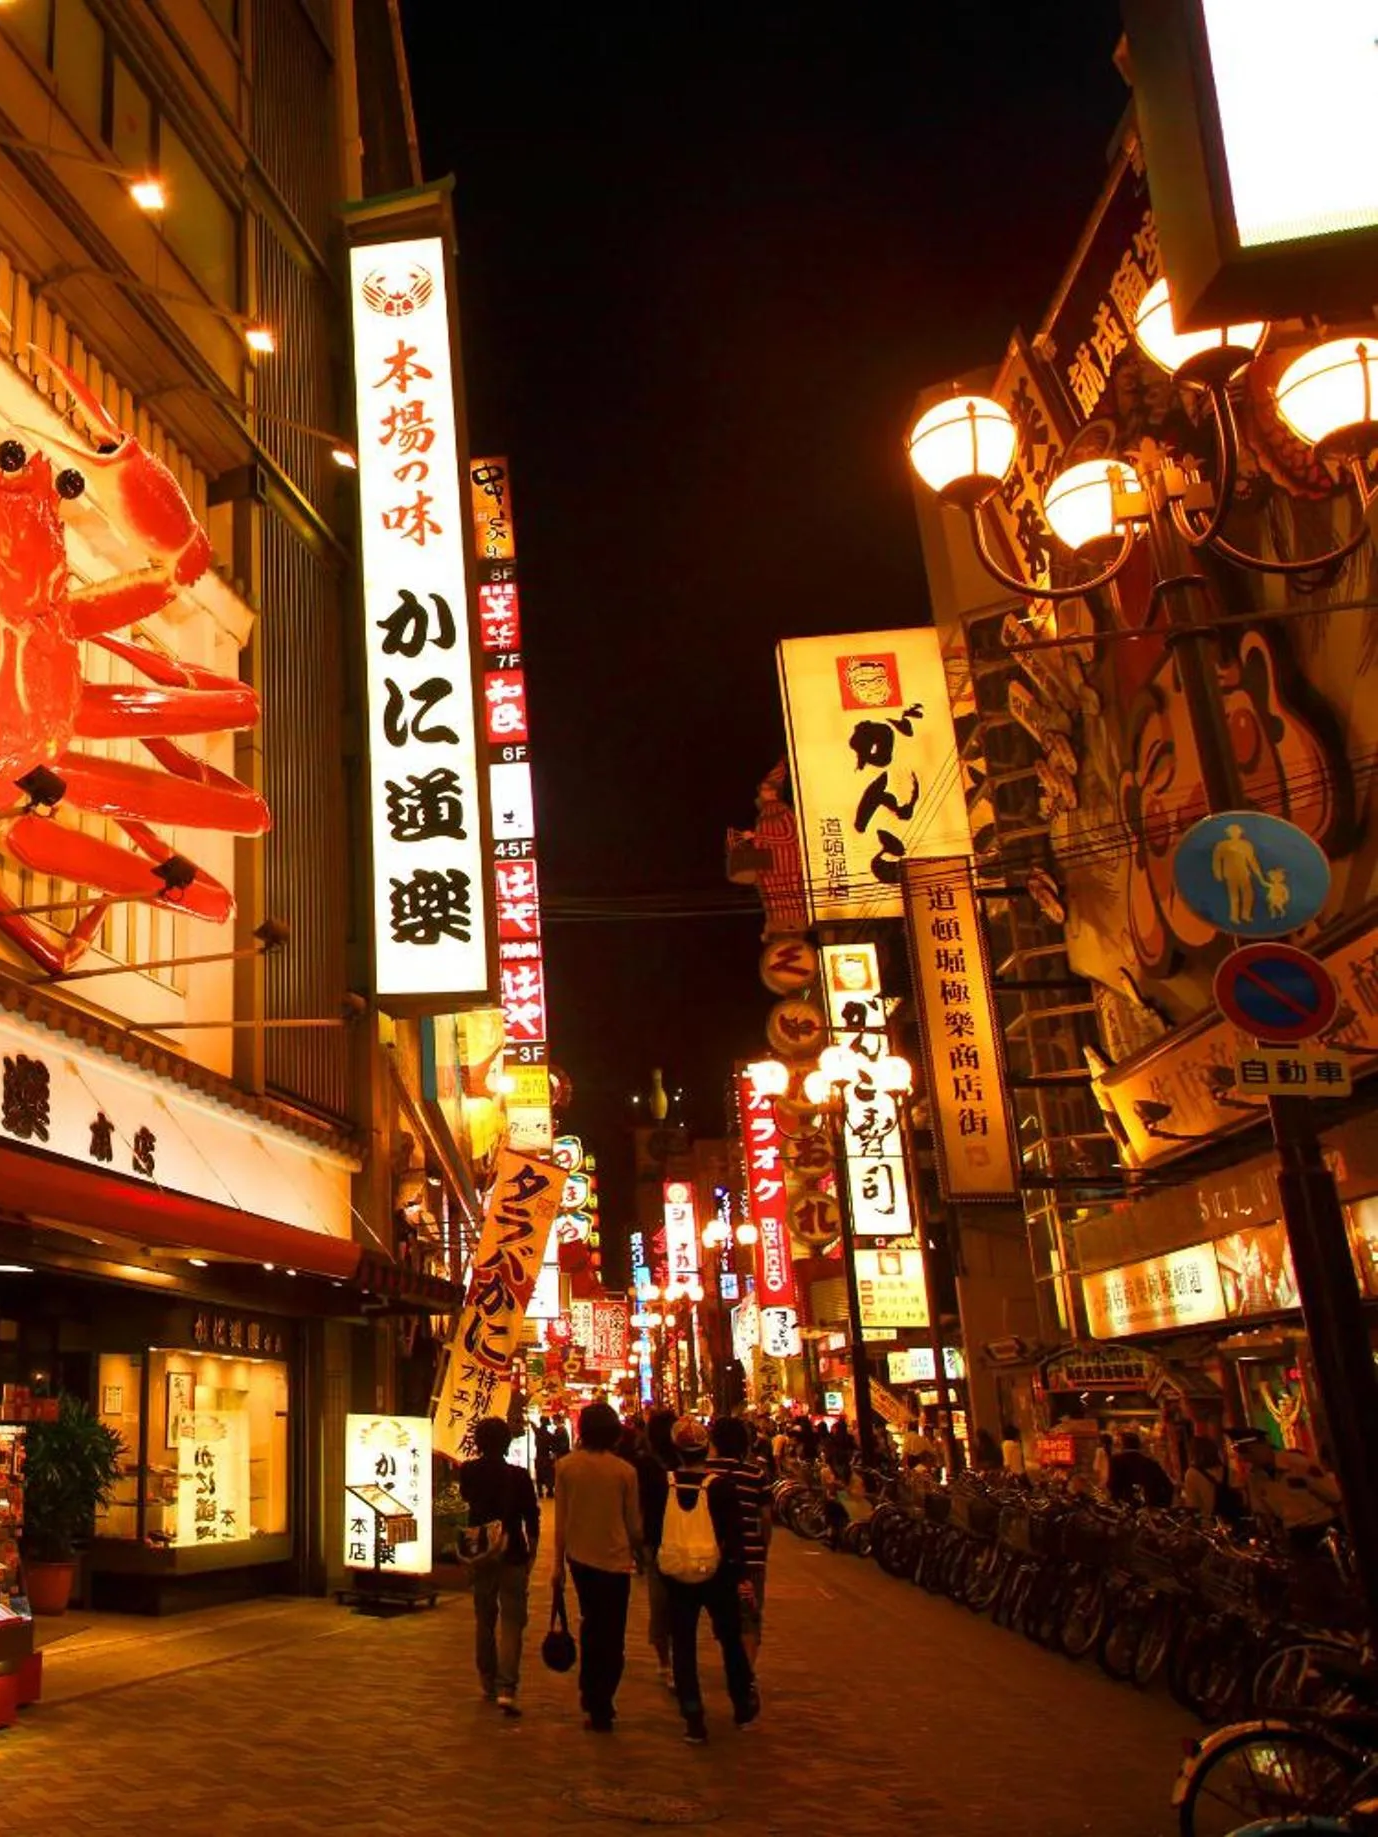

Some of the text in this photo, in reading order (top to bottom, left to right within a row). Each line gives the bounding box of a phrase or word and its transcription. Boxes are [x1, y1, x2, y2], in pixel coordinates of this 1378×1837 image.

[372, 340, 443, 547] 本場の味
[490, 568, 515, 582] 8F
[497, 654, 521, 669] 7F
[502, 747, 527, 761] 6F
[1240, 1058, 1346, 1086] 自動車
[464, 1164, 551, 1364] タラバかに
[348, 1516, 368, 1561] 本店
